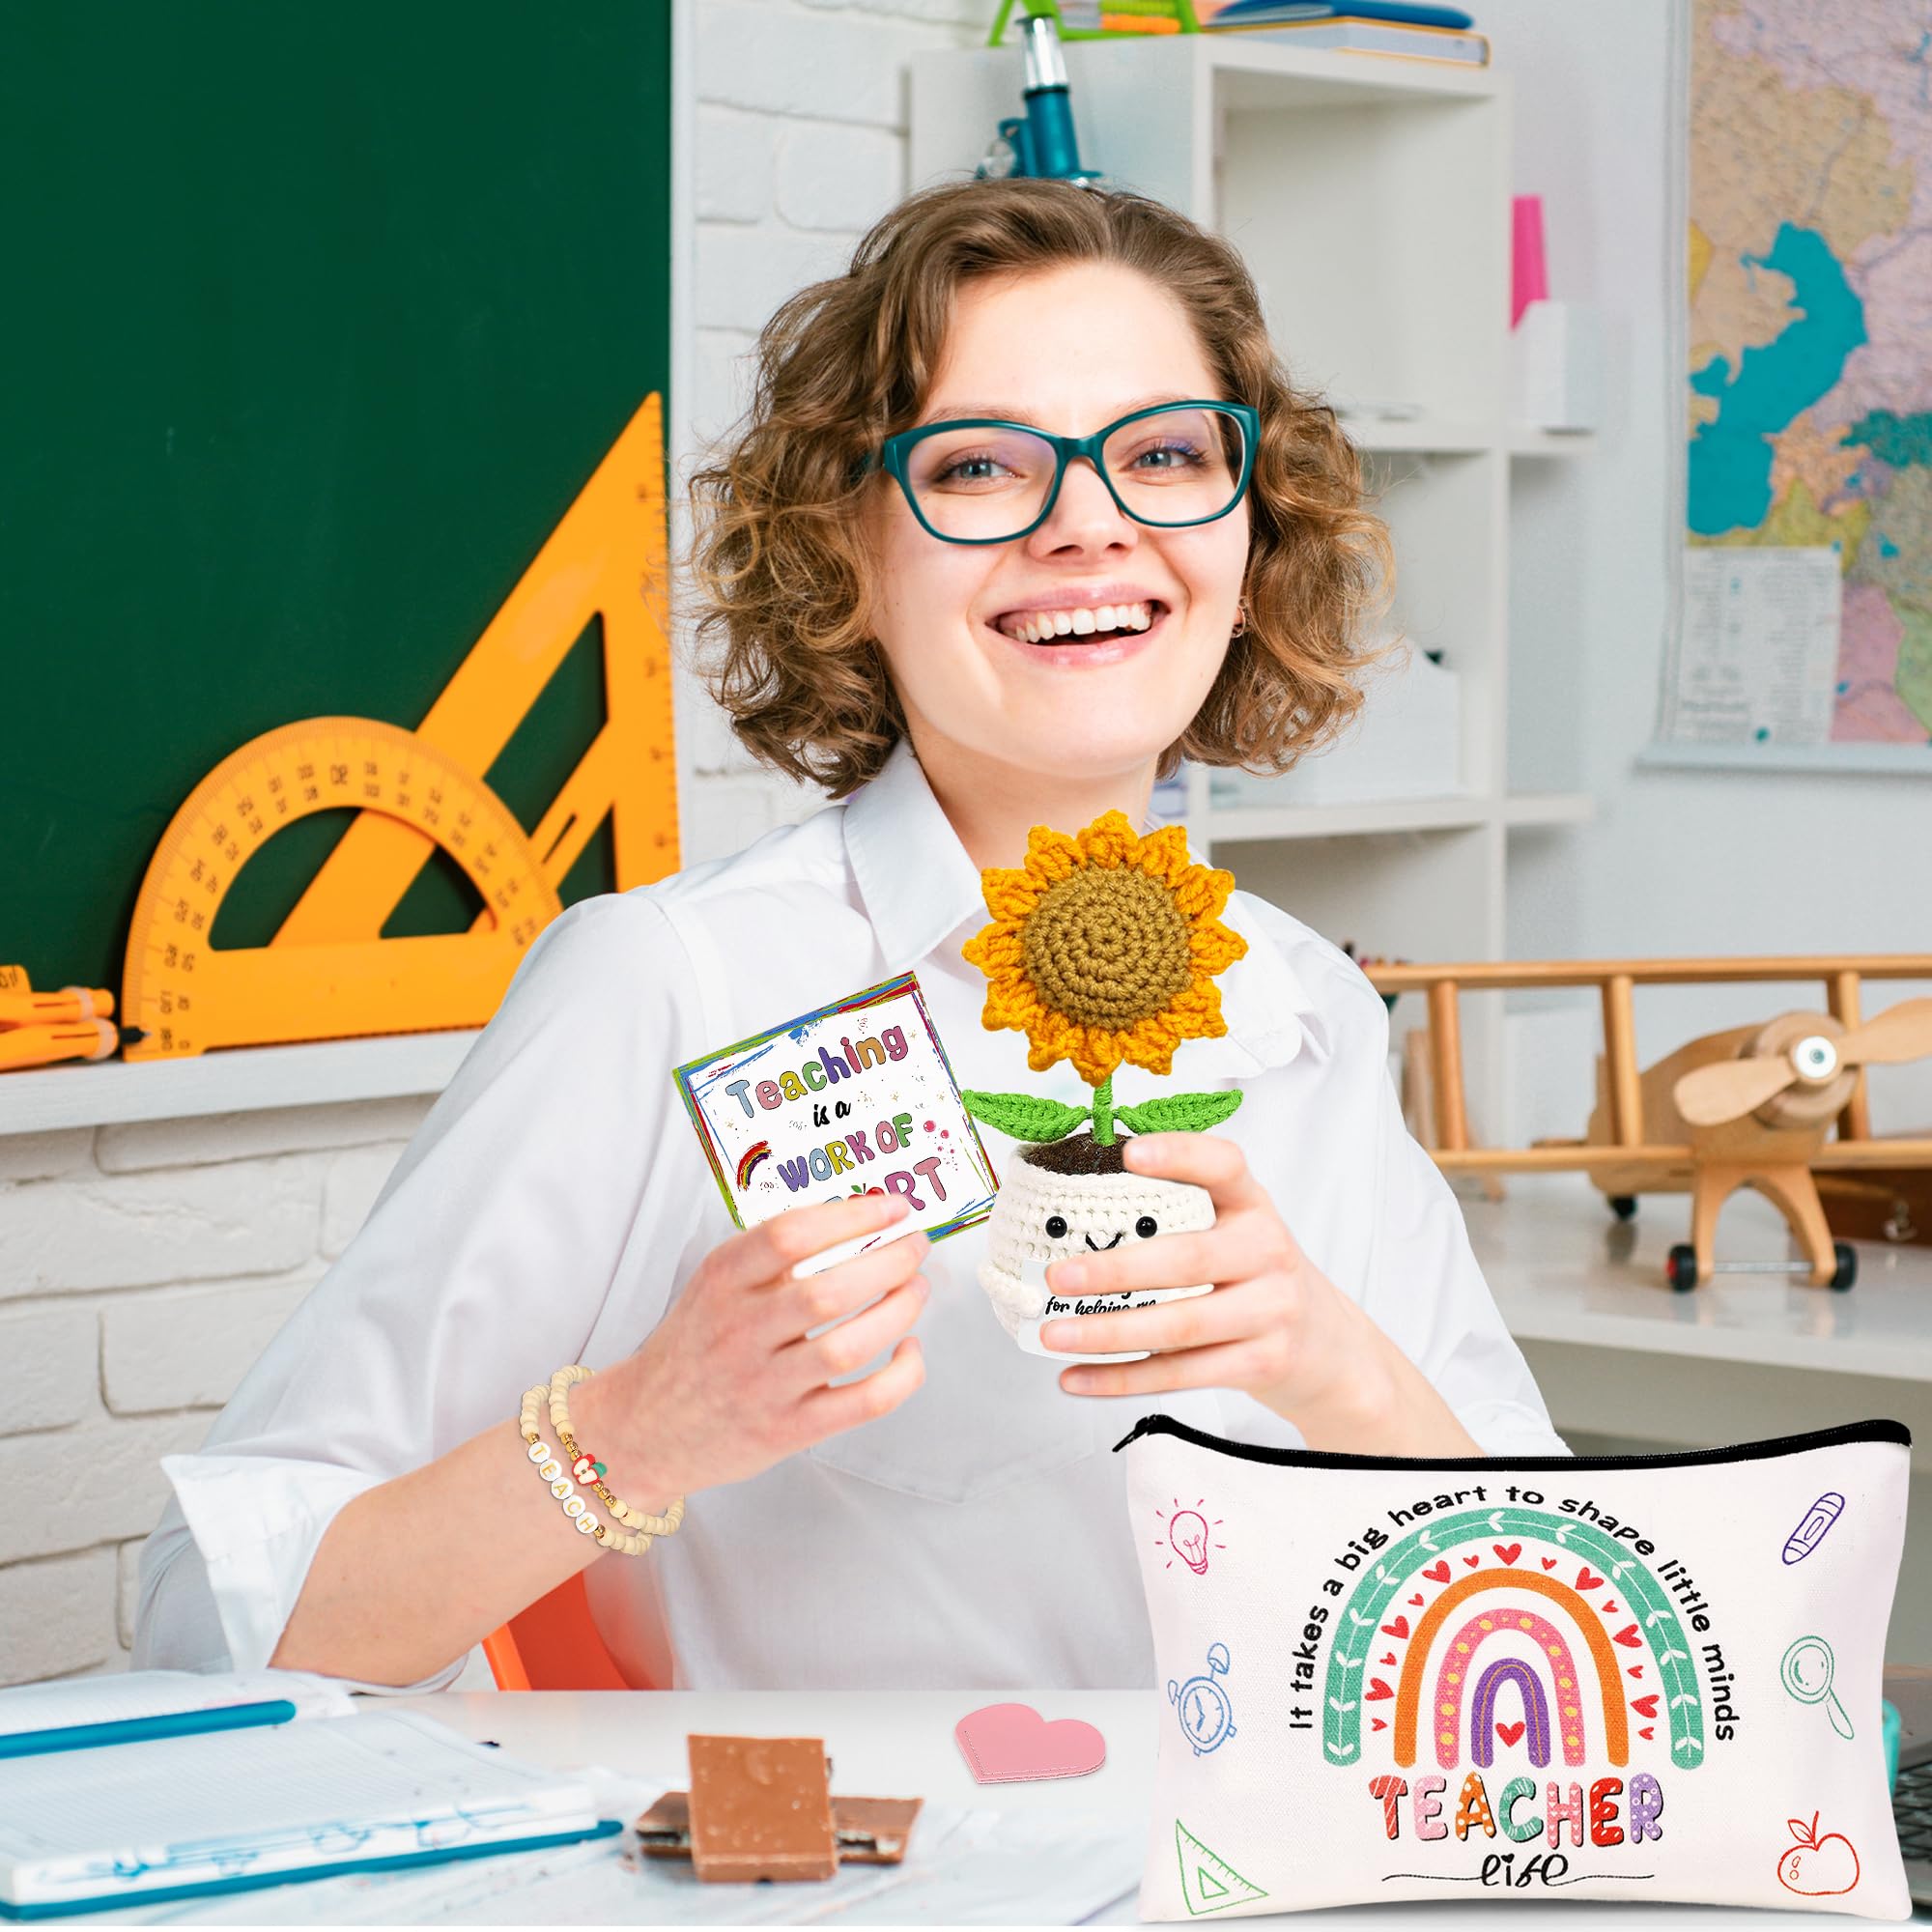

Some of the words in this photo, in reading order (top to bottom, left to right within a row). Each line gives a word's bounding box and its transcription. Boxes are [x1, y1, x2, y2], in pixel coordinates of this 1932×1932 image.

[725, 1025, 909, 1119] Teaching
[813, 1103, 831, 1128] is
[835, 1100, 852, 1118] a
[776, 1130, 876, 1192] WORK
[875, 1112, 914, 1154] OF
[1045, 1295, 1070, 1315] for
[532, 1445, 597, 1532] TEACH
[1387, 1486, 1488, 1527] heart
[1505, 1486, 1545, 1505] to
[1334, 1527, 1389, 1572] big
[1557, 1498, 1656, 1556] shape
[1322, 1577, 1345, 1597] a
[1657, 1559, 1711, 1633] little
[1289, 1605, 1329, 1693] takes
[1289, 1705, 1313, 1729] It
[1701, 1643, 1740, 1741] minds
[1368, 1772, 1664, 1850] TEACHER
